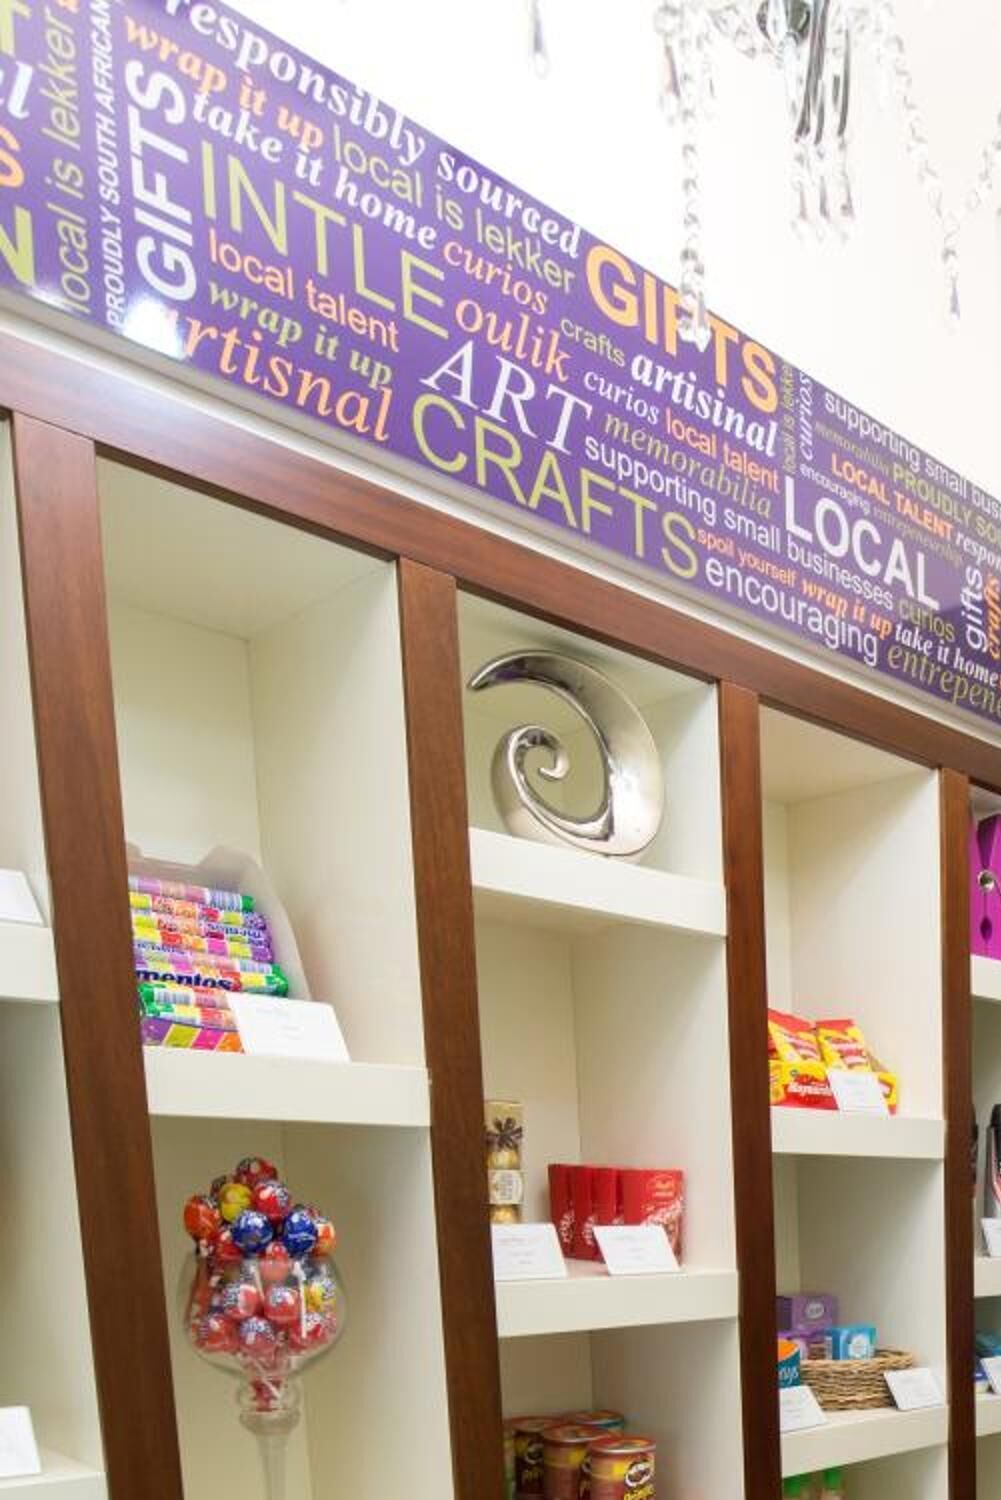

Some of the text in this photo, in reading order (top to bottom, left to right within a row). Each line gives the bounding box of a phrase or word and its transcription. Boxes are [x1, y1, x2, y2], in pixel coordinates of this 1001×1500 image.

[38, 5, 80, 150] lekker
[125, 16, 324, 148] wrap it up
[44, 158, 84, 199] is
[96, 111, 120, 205] SOUTH
[125, 59, 197, 301] GIFTS
[193, 93, 437, 250] take it home
[333, 124, 577, 293] local is lekker
[437, 152, 582, 259] sourced
[47, 202, 91, 314] local
[99, 204, 126, 329] PROUDLY
[202, 140, 449, 339] INTLE
[208, 227, 399, 352] local talent
[444, 241, 548, 315] curios
[158, 310, 393, 441] rtisnal
[208, 281, 392, 390] wrap it up
[455, 300, 573, 383] oulik
[561, 319, 626, 367] crafts
[419, 340, 593, 455] ART
[584, 371, 659, 425] curios
[632, 355, 779, 457] artisinal
[666, 408, 781, 494] local talent
[825, 391, 921, 473] supporting
[925, 458, 967, 499] small
[412, 394, 699, 579] CRAFTS
[585, 435, 894, 611] supporting small businesses
[831, 452, 954, 540] LOCAL TALENT
[893, 462, 971, 525] PROUDLY
[697, 529, 798, 588] spoil yourself
[785, 474, 940, 611] LOCAL
[705, 557, 879, 667] encouraging
[802, 579, 893, 640] wrap it up
[895, 624, 999, 687] take it home
[896, 599, 957, 643] curios
[960, 566, 988, 654] gifts
[136, 969, 235, 991] mentos
